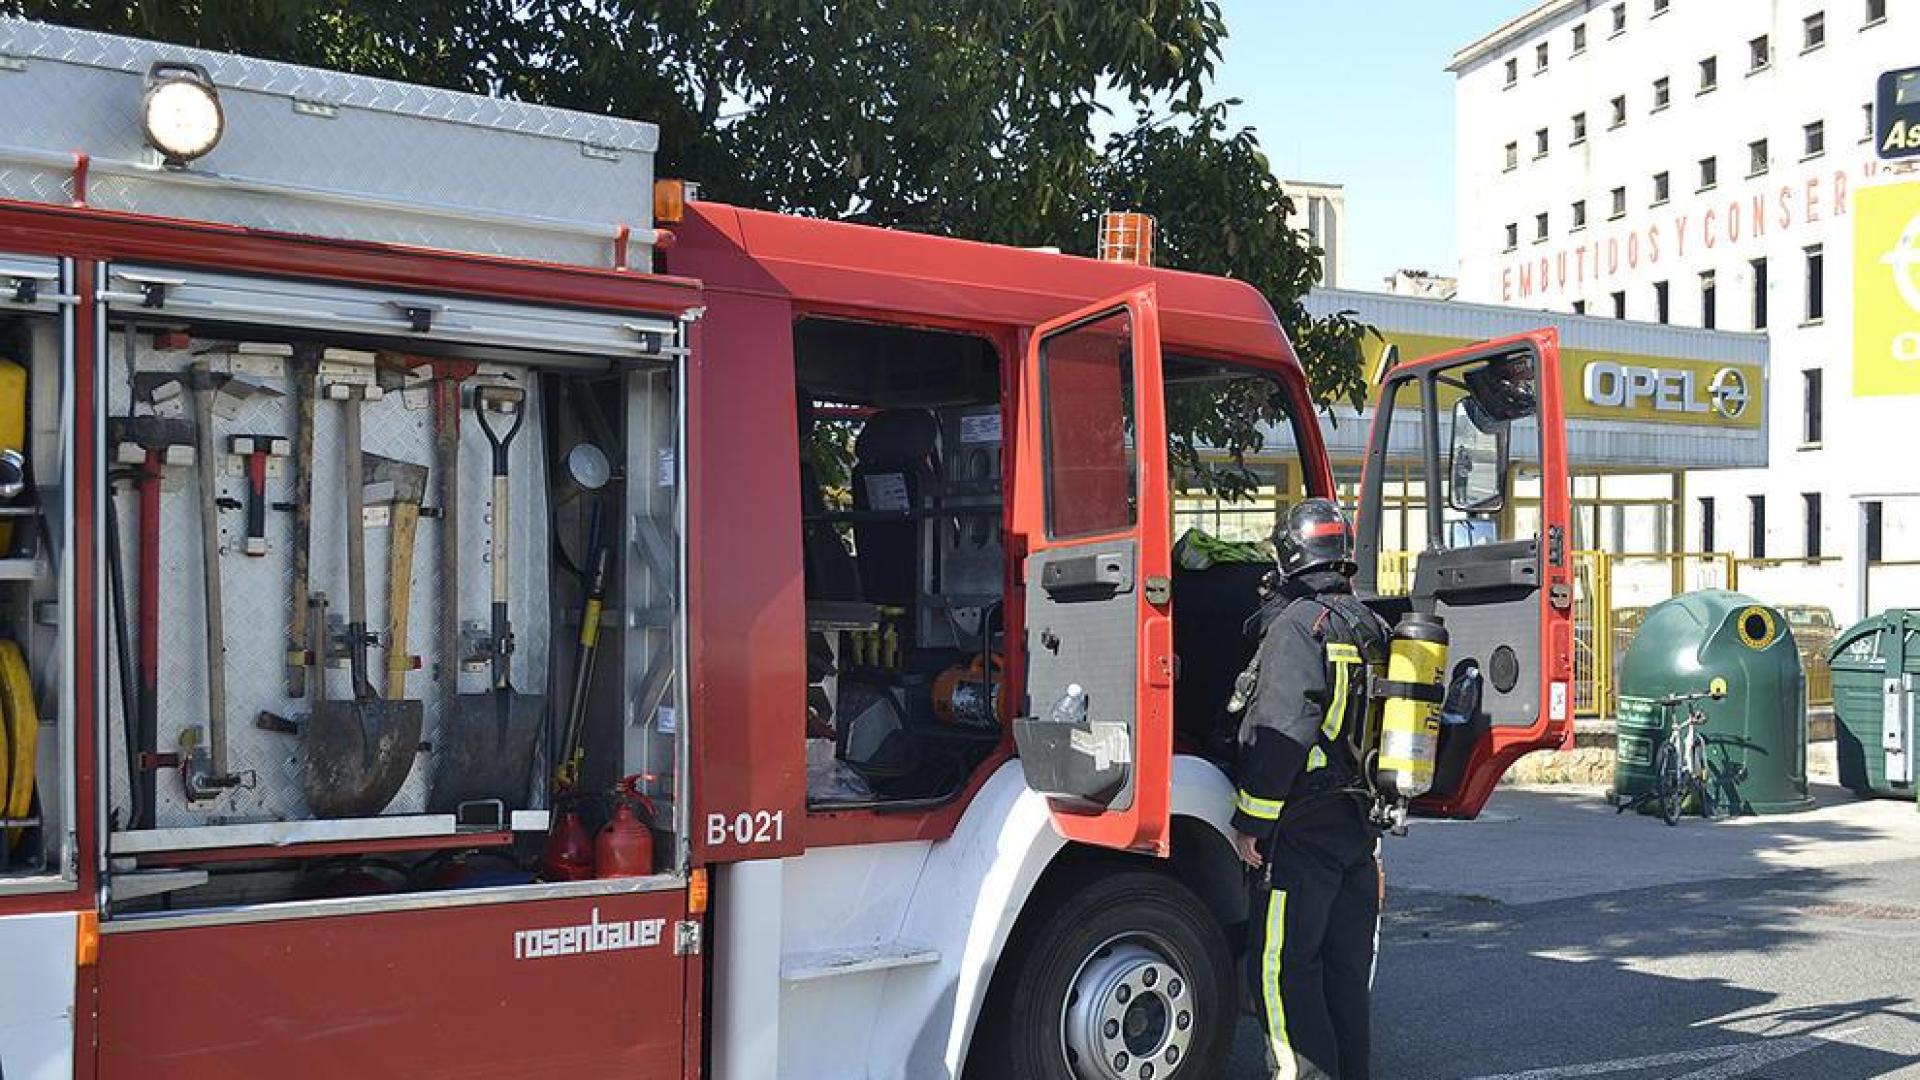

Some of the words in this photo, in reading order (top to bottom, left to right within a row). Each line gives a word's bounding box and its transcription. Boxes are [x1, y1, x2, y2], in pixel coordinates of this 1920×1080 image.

[1502, 224, 1660, 303] EMBUTIDOS
[1676, 215, 1688, 257] Y
[1584, 361, 1709, 412] OPEL
[707, 810, 783, 845] B-021
[515, 907, 666, 959] rosenbauer
